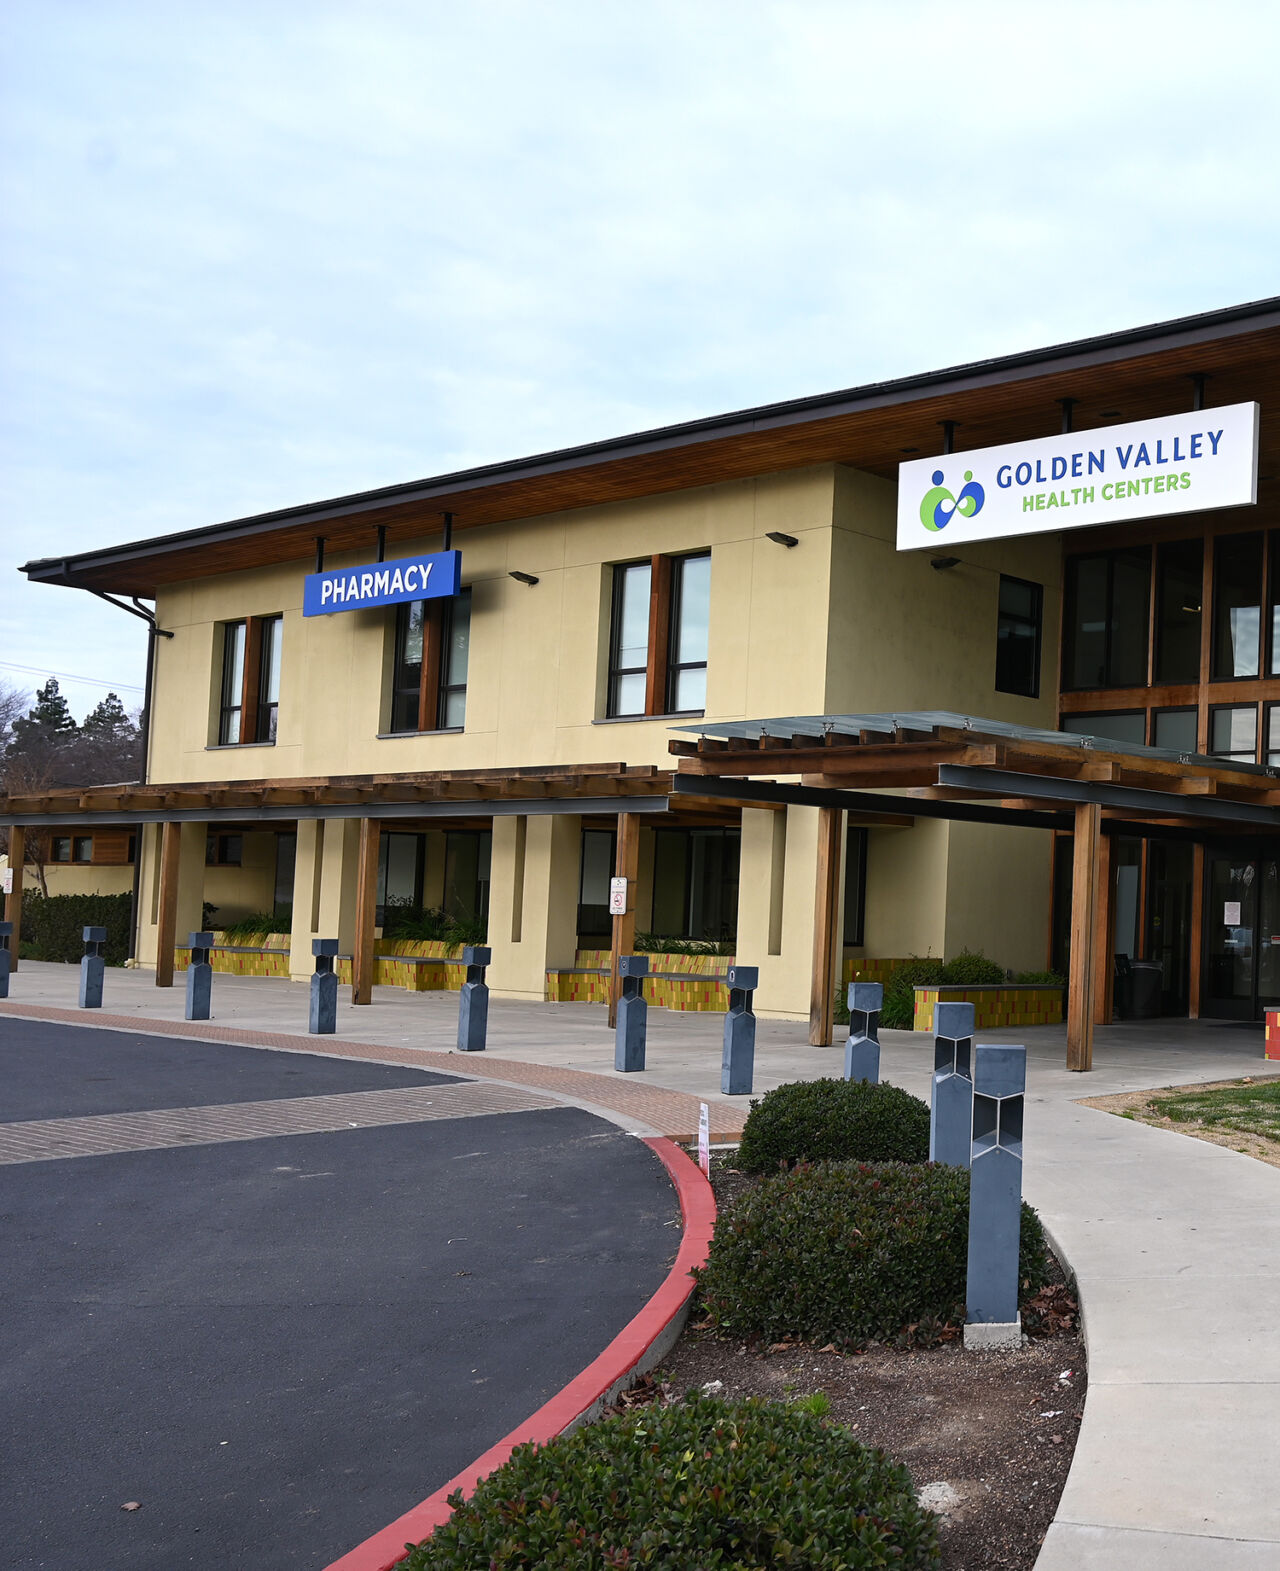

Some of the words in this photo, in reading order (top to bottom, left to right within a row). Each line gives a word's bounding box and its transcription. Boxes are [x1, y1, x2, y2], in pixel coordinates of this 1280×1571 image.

[996, 449, 1105, 489] GOLDEN
[1116, 429, 1224, 470] VALLEY
[1022, 486, 1095, 513] HEALTH
[1101, 471, 1191, 501] CENTERS
[320, 562, 433, 605] PHARMACY
